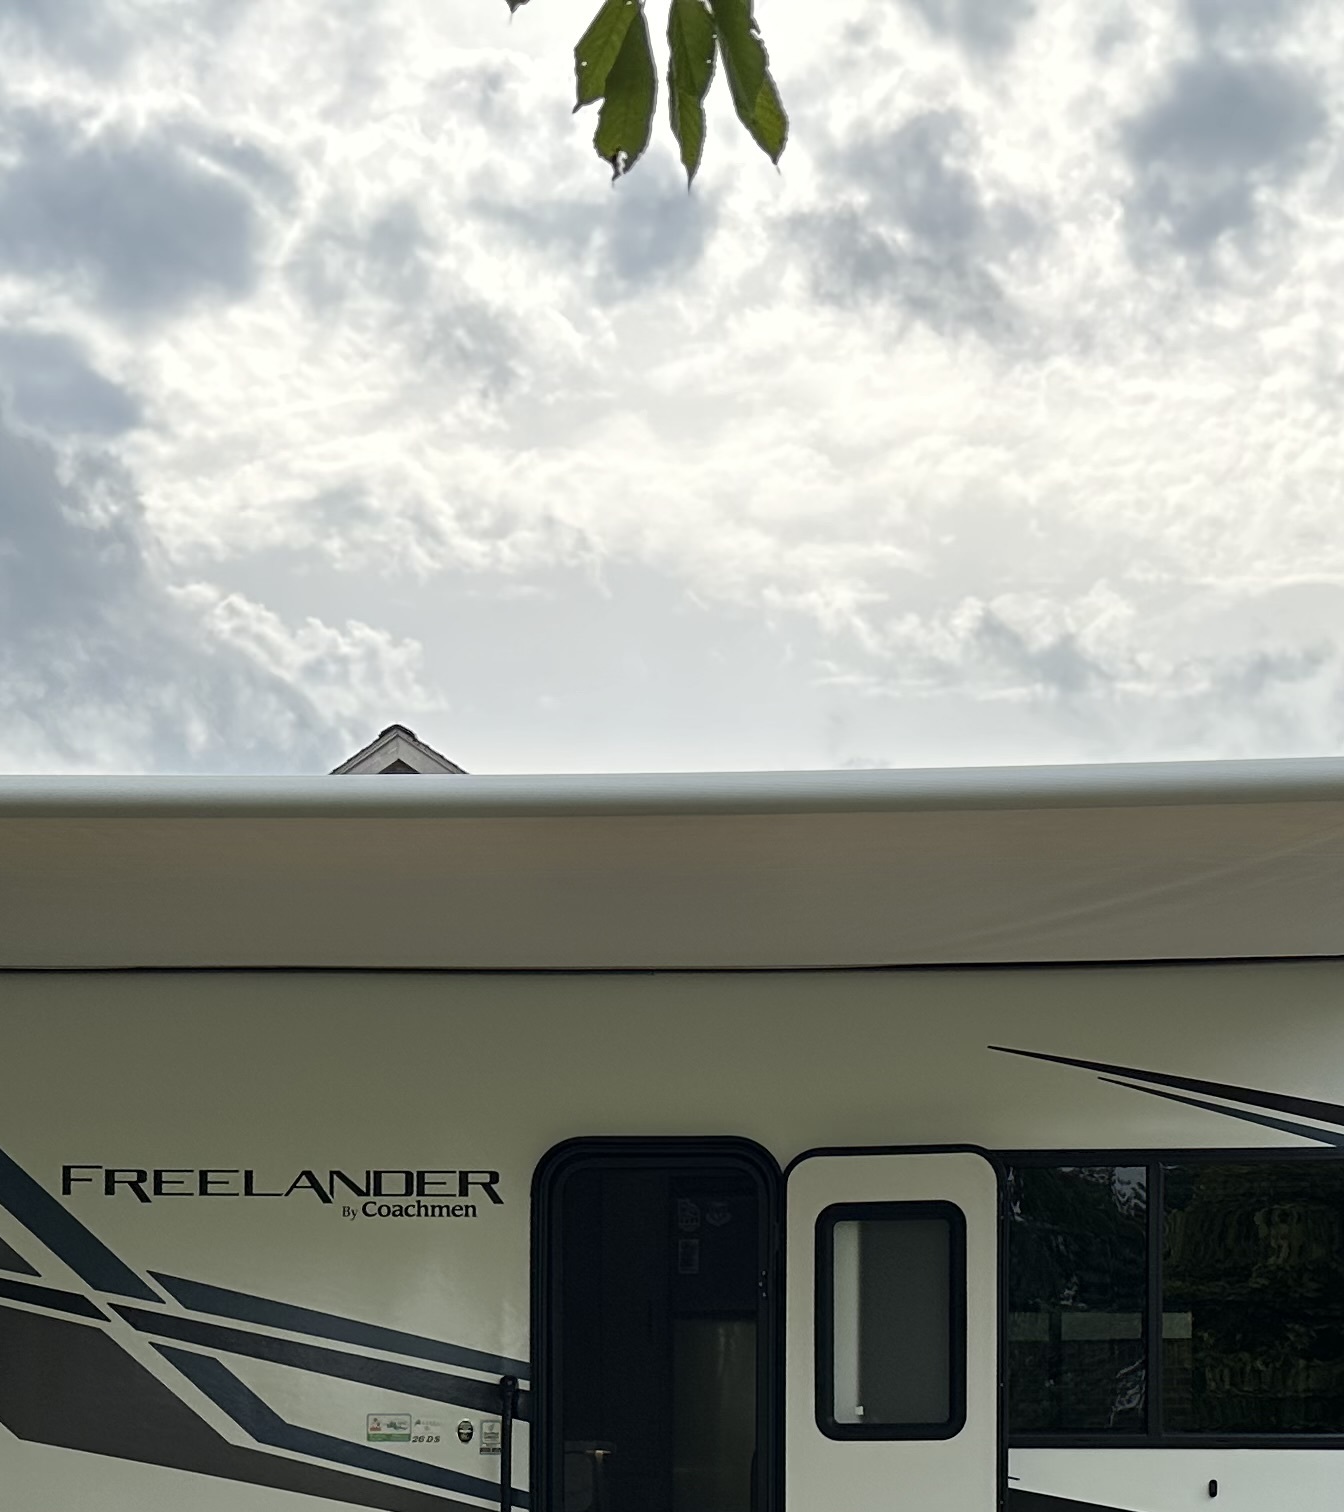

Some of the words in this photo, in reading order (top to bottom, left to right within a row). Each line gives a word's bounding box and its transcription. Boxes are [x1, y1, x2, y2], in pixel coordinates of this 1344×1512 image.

[61, 1164, 504, 1204] FREELANDER
[342, 1205, 358, 1221] By
[361, 1200, 477, 1218] Coachmen
